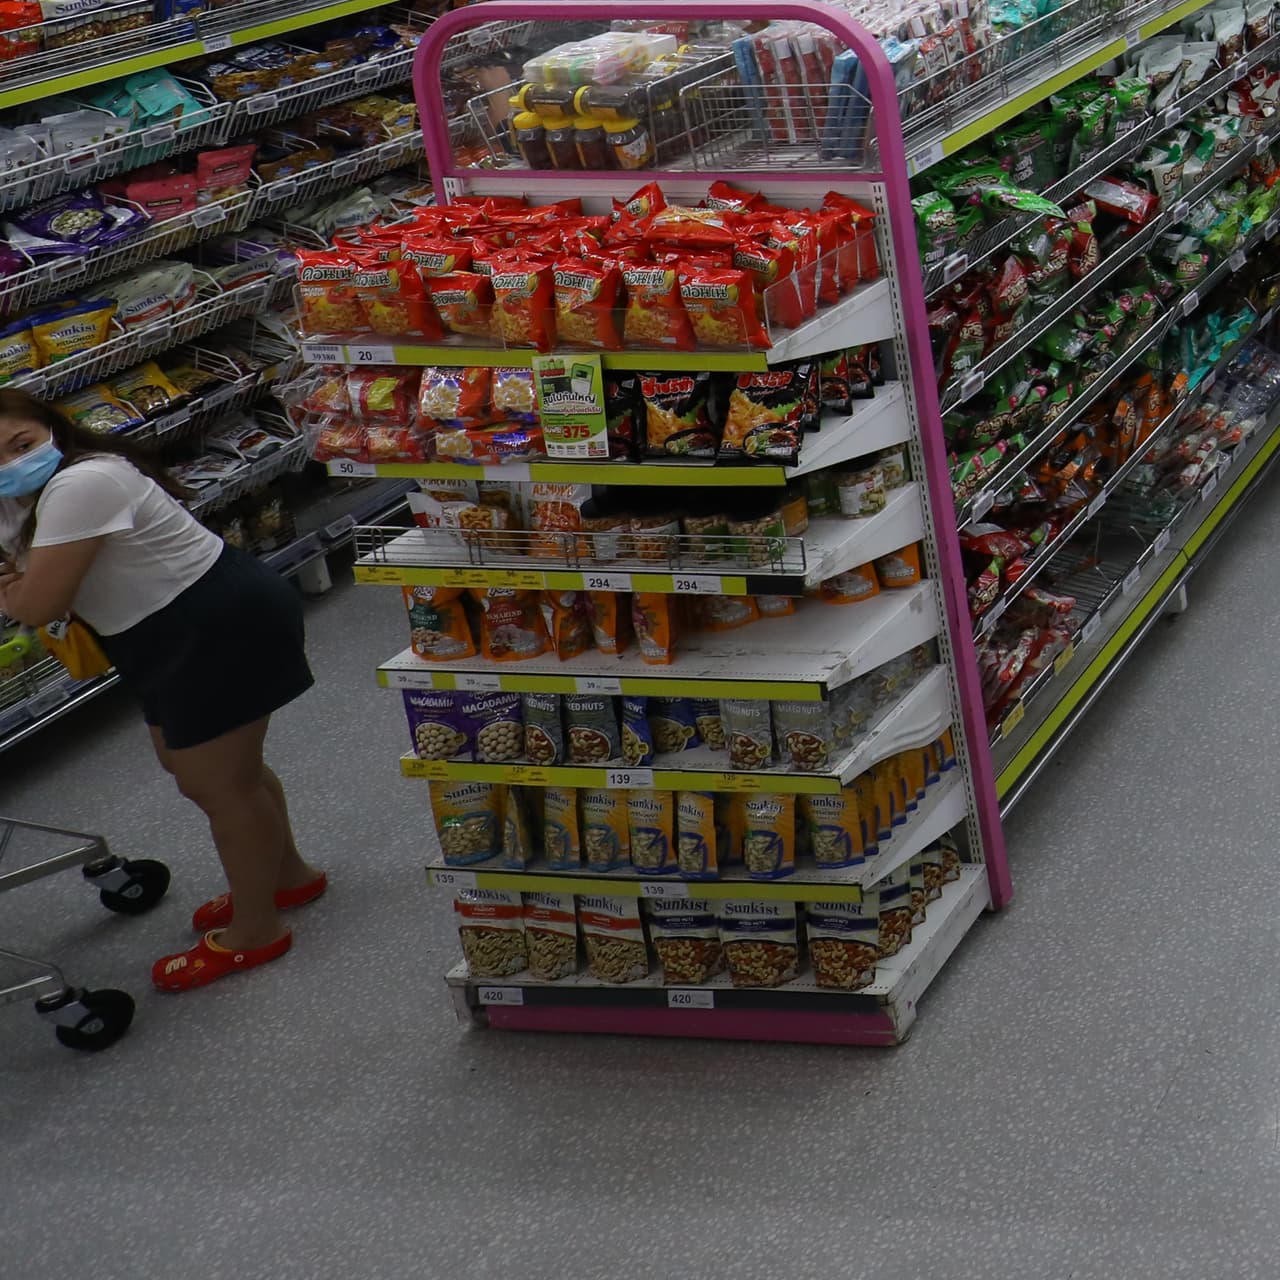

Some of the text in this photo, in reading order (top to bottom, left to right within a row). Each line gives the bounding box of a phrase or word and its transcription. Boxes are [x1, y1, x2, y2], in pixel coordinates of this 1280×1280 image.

[125, 292, 168, 314] Sunkist
[358, 351, 373, 361] 20
[563, 425, 591, 439] 375
[340, 463, 354, 473] 50
[588, 578, 610, 589] 294
[675, 579, 698, 591] 294
[581, 702, 605, 712] NUTS
[610, 774, 630, 785] 139
[435, 874, 454, 884] 139
[644, 886, 665, 895] 139
[654, 897, 708, 912] Sunkist
[724, 902, 780, 916] Sunkist
[483, 991, 503, 1001] 420
[671, 994, 692, 1005] 420
